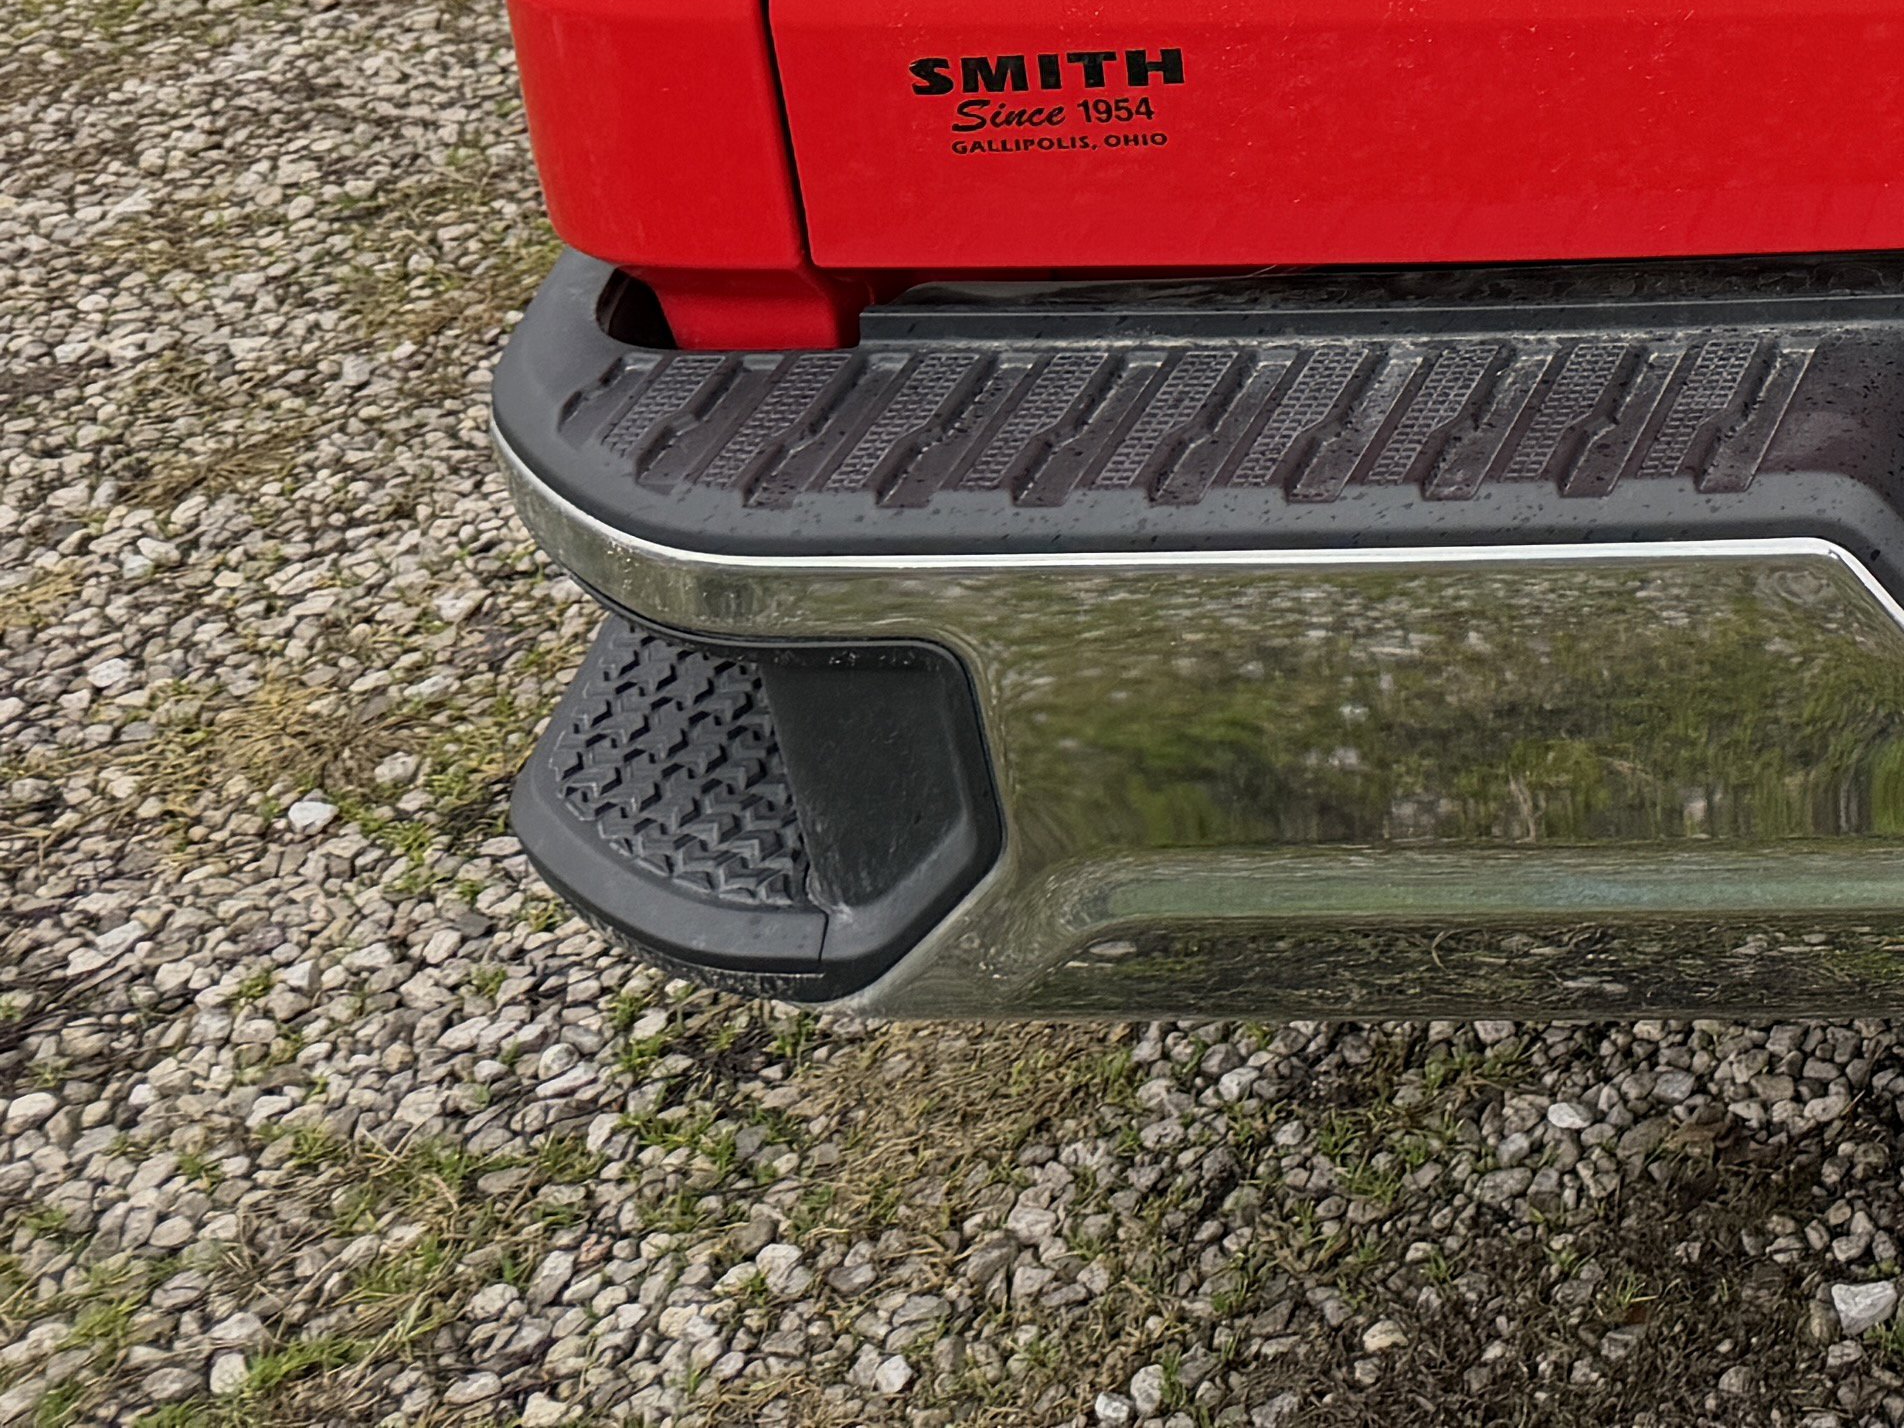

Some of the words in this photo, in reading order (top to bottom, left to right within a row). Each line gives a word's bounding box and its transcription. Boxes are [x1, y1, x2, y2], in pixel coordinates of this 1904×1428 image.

[908, 48, 1185, 95] SMITH
[951, 98, 1067, 133] Since
[1076, 96, 1155, 124] 1954
[951, 135, 1099, 155] GALLIPOLIS,
[1103, 132, 1169, 148] OHIO
